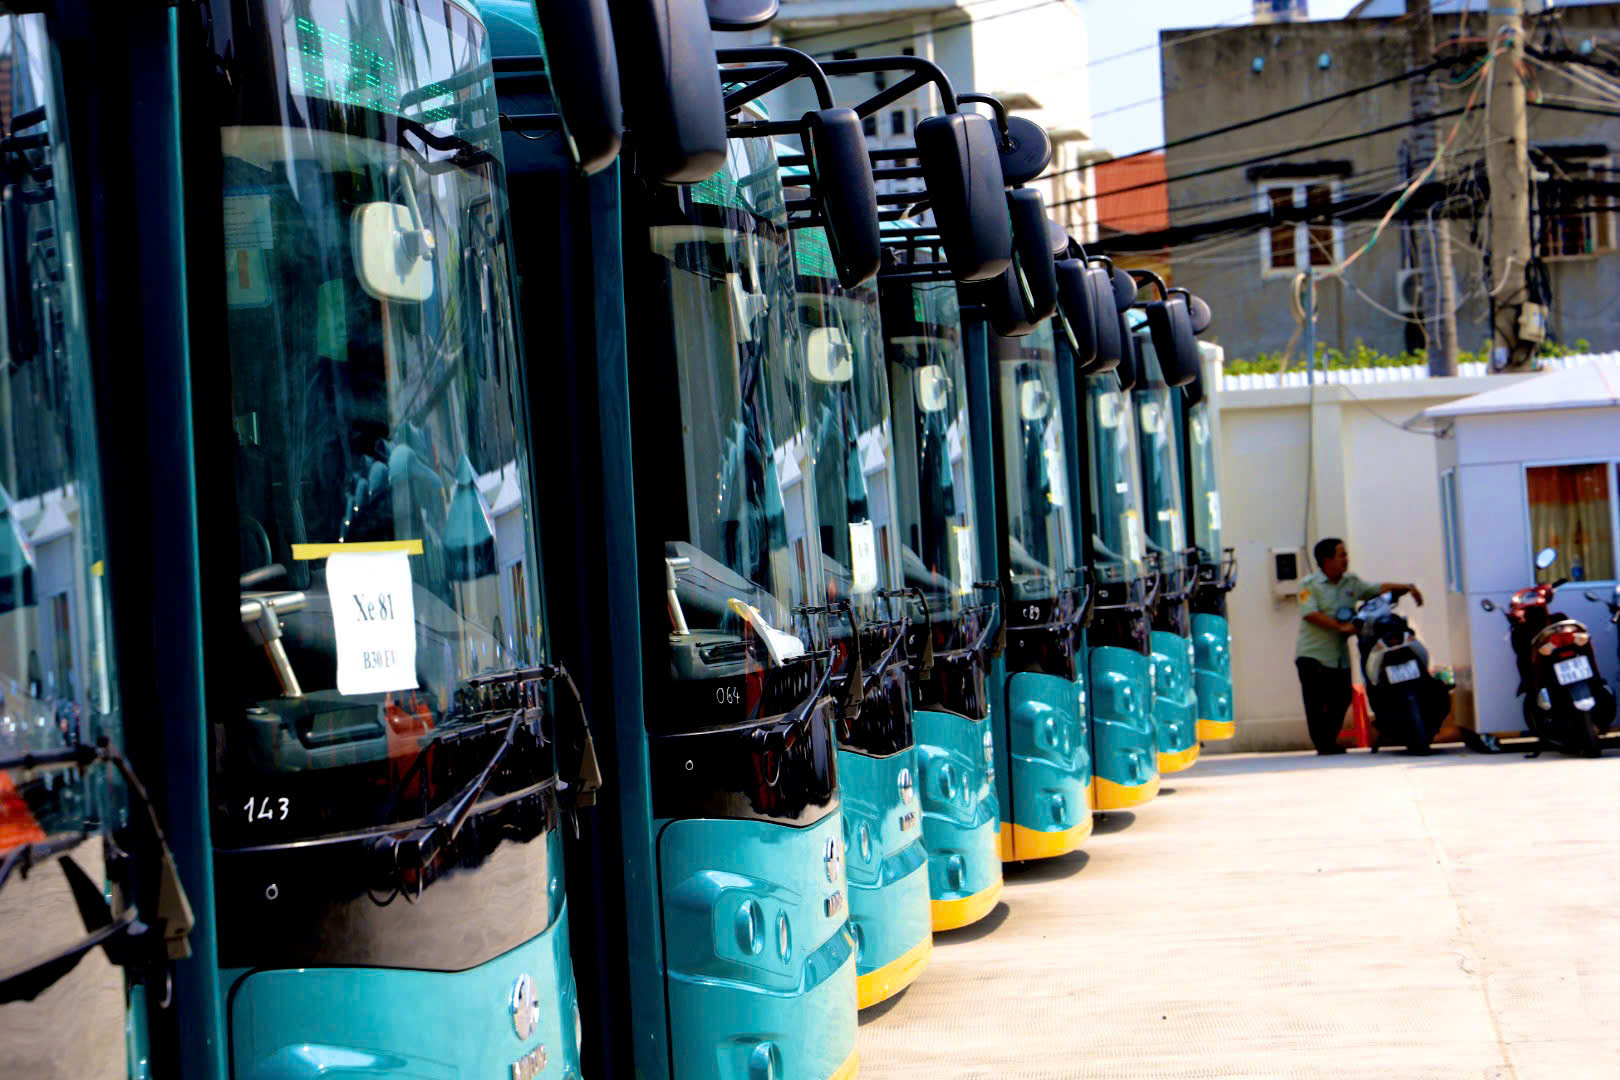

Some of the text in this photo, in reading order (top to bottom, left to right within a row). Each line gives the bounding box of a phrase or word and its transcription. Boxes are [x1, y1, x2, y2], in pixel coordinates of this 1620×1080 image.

[353, 592, 394, 621] Xe 81
[716, 686, 740, 704] 064
[243, 796, 290, 823] 143
